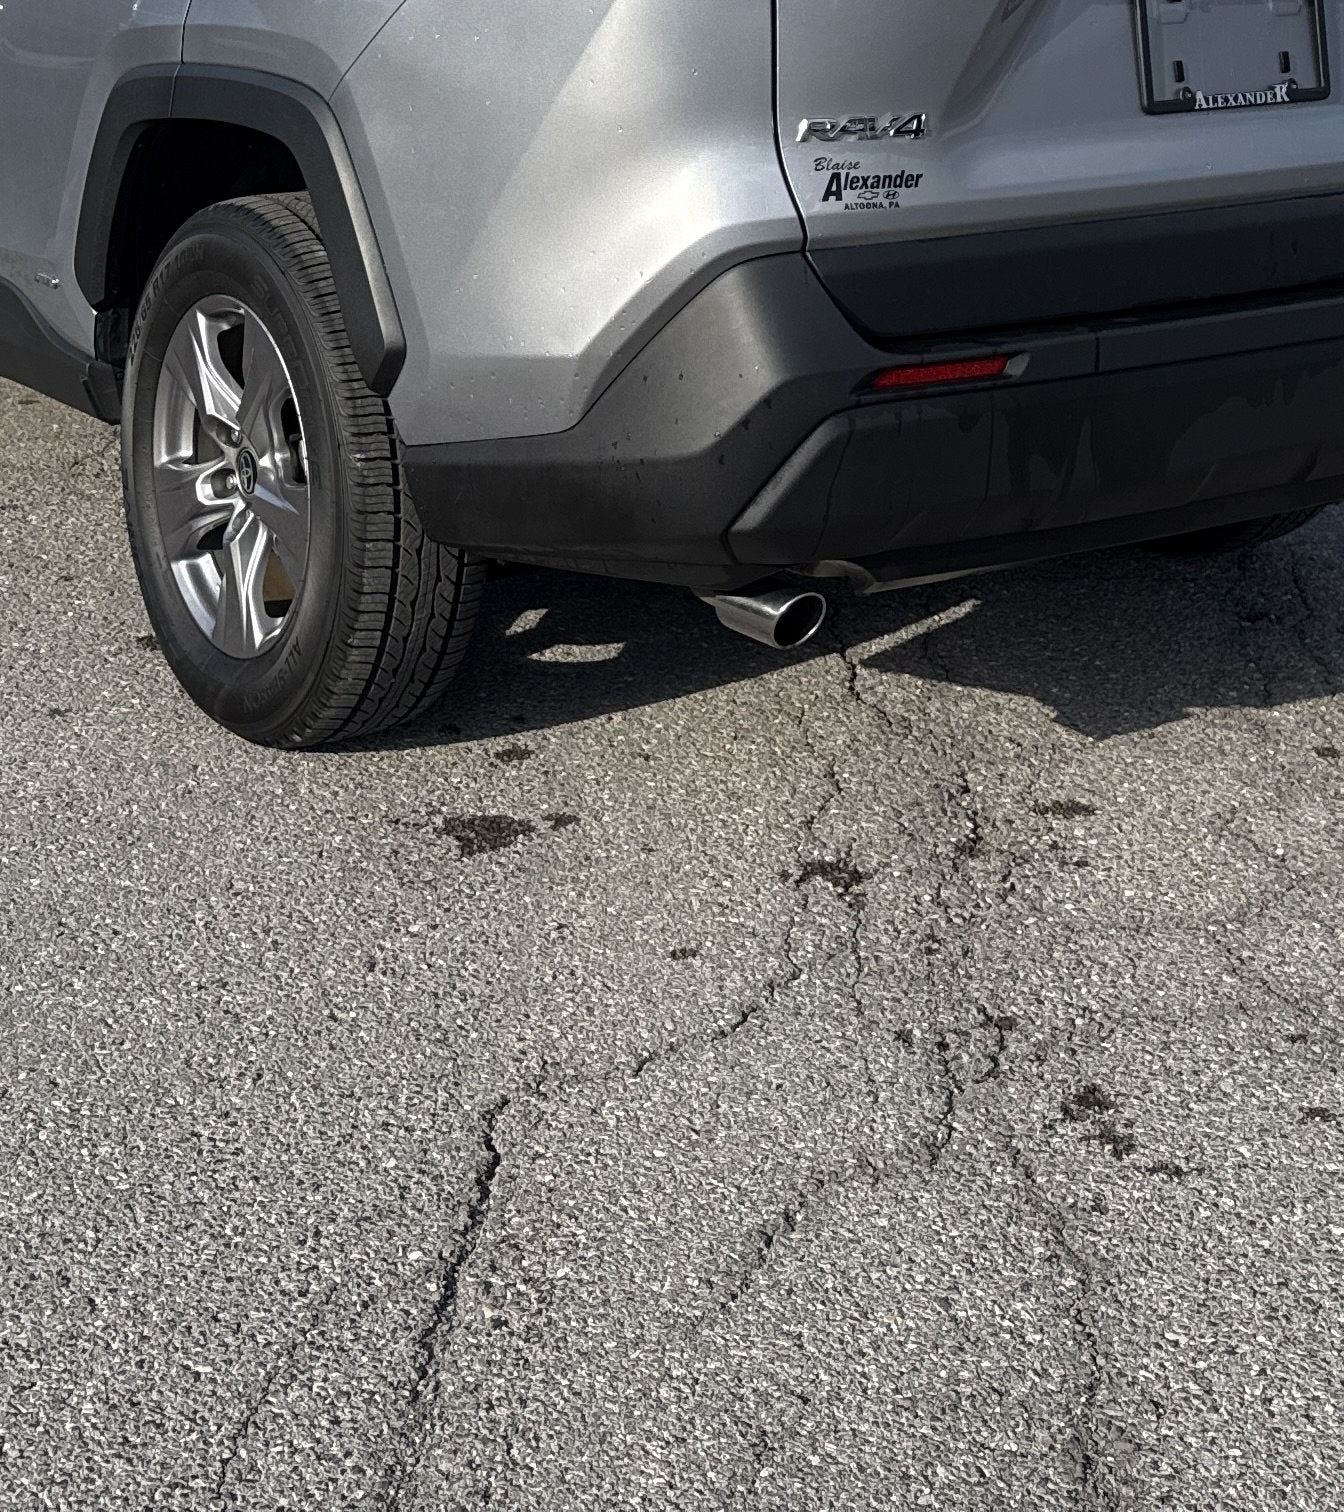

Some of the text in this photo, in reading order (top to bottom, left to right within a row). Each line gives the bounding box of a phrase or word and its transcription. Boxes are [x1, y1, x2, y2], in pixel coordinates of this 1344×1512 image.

[1194, 84, 1290, 110] ALEXANDER
[795, 112, 926, 142] RAV4
[814, 156, 861, 172] Blaise
[822, 170, 924, 202] Alexander
[889, 201, 900, 209] PA
